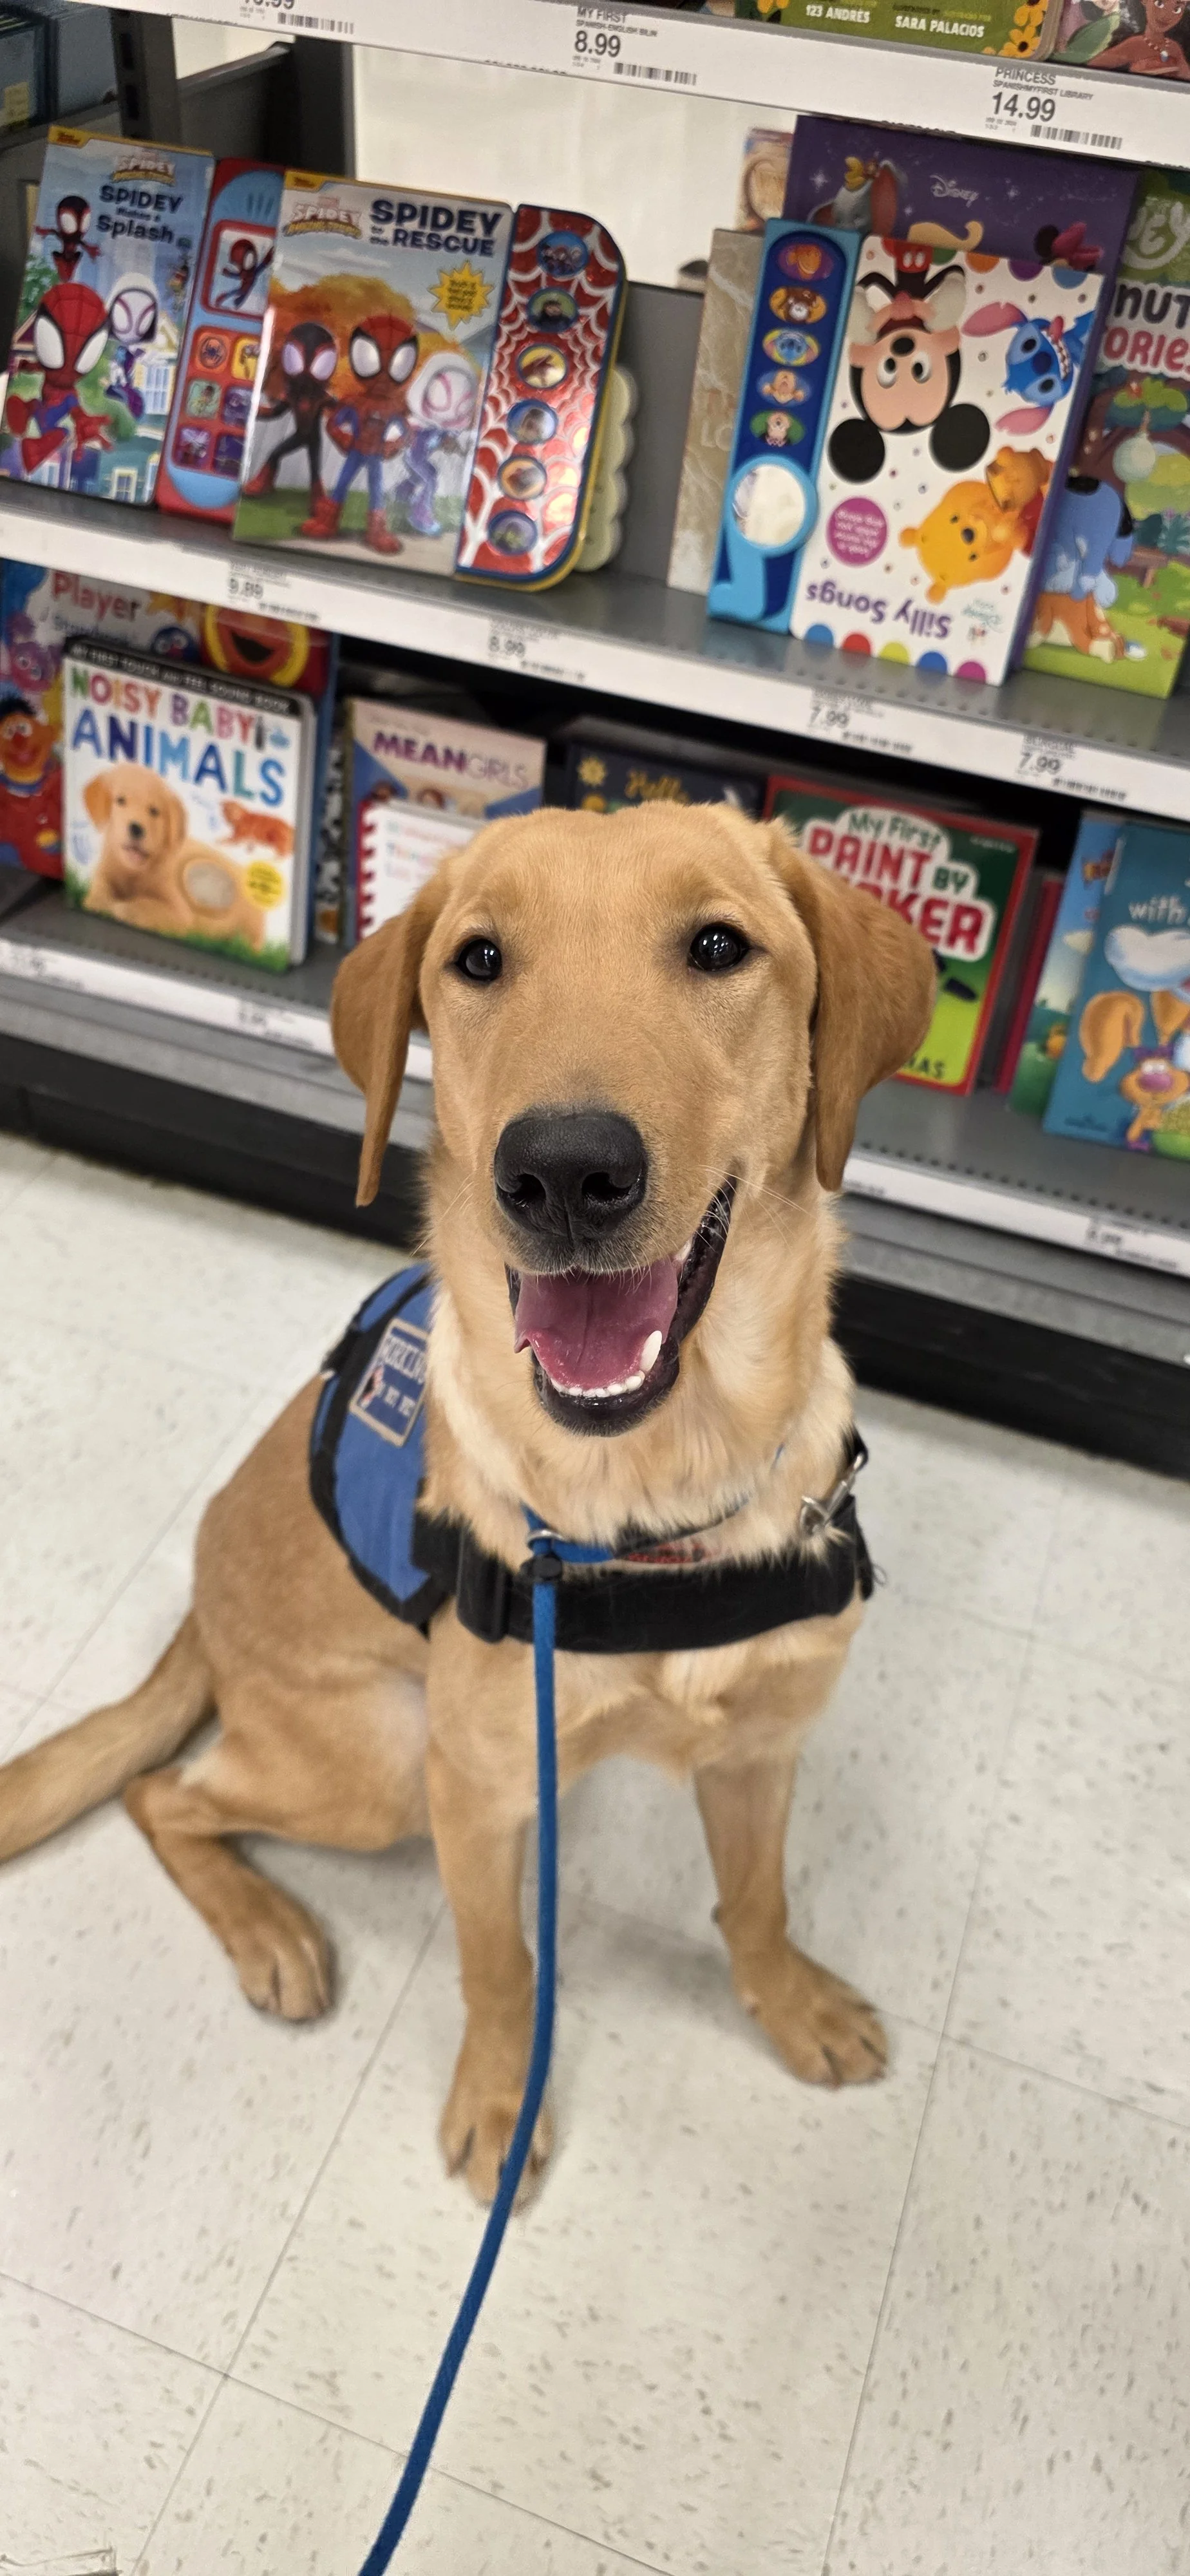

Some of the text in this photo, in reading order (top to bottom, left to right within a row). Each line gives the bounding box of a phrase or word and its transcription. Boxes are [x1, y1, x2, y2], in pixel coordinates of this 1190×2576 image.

[596, 9, 627, 24] FIRST
[806, 5, 823, 17] 123
[895, 15, 926, 31] SARA
[930, 19, 985, 38] PALACIOS
[574, 30, 621, 57] 8.99
[995, 66, 1057, 86] PRINCESS
[992, 91, 1056, 122] 14.99
[99, 184, 184, 214] SPIDEY
[930, 173, 979, 208] Disney
[97, 214, 173, 244] Splash
[370, 198, 505, 238] SPIDEY
[392, 227, 495, 257] RESCUE
[53, 569, 142, 622] Player
[807, 580, 886, 624] Songs
[893, 598, 951, 639] Silly
[71, 667, 254, 744] NOISY BABY
[71, 708, 285, 807] ANIMALS
[373, 730, 468, 772] MEAN
[848, 811, 884, 837] My
[887, 814, 940, 849] First
[808, 826, 969, 896] PAINT BY
[1128, 895, 1186, 925] with
